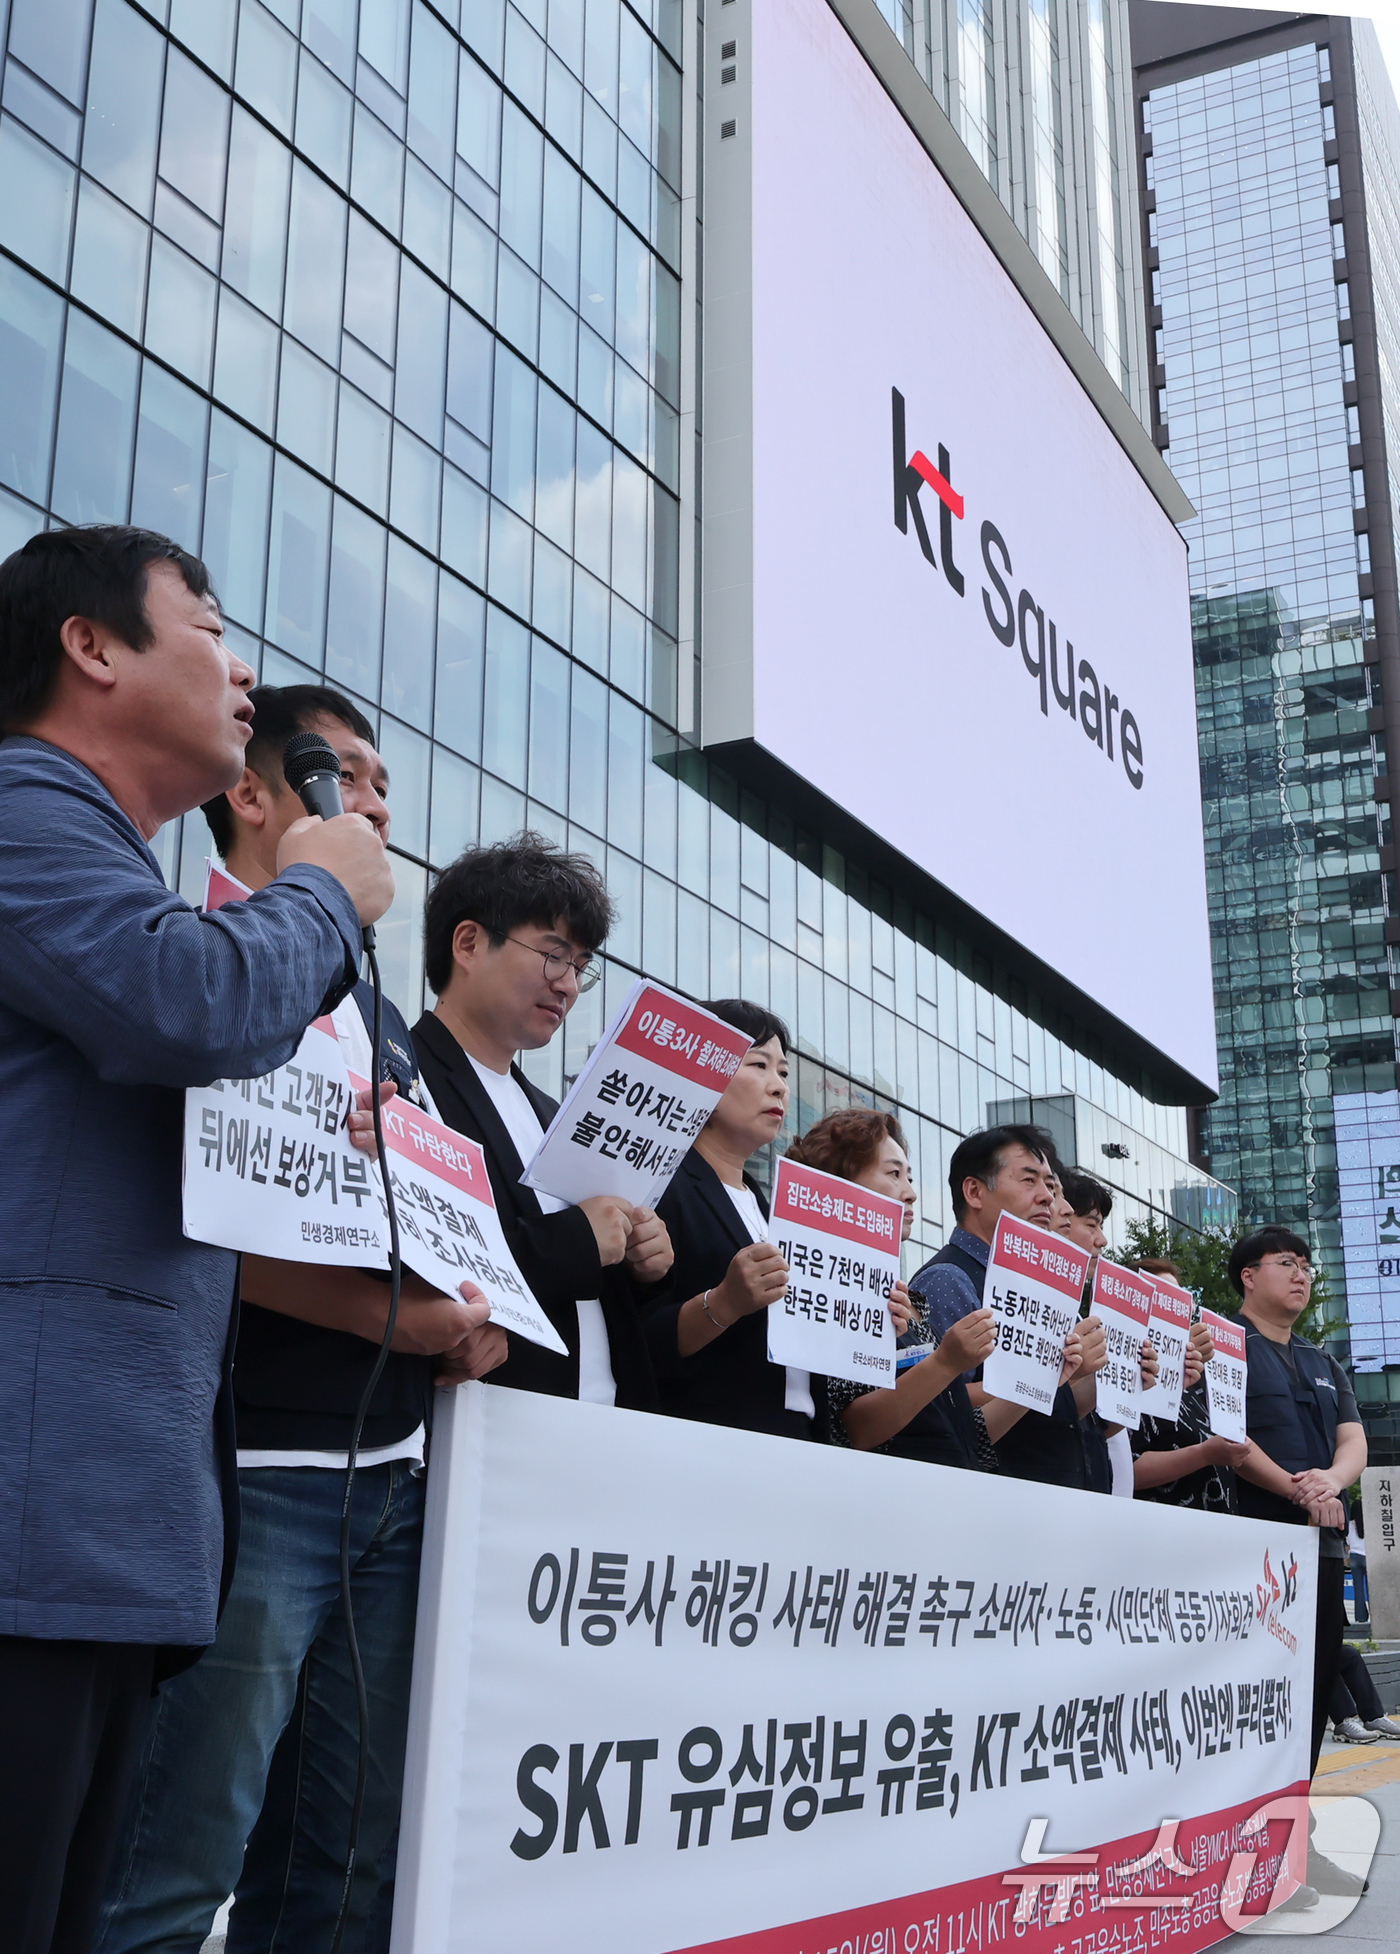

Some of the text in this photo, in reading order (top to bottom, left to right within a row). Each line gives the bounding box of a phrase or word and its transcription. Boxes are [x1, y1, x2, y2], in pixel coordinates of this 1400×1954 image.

[891, 385, 1144, 791] kt Square
[637, 1010, 702, 1060] 이통3사
[597, 1068, 689, 1132] 쏟아지는
[199, 1106, 372, 1207] 뒤에선 보상거부
[382, 1105, 405, 1139] KT
[409, 1120, 473, 1180] 규탄한다
[570, 1111, 669, 1176] 불안해서
[301, 1221, 380, 1248] 민생경제연구소
[390, 1169, 489, 1251] 소액결제
[786, 1181, 894, 1240] 집단소송제도 도입하라
[425, 1228, 530, 1303] 조사하라
[778, 1239, 895, 1300] 미국은 7천억 배상
[1003, 1231, 1083, 1287] 반복되는 개인정보 유출
[1100, 1273, 1114, 1296] 해킹
[783, 1285, 884, 1338] 한국은 배상 0원
[990, 1285, 1073, 1338] 노동자만 죽어난다
[852, 1351, 891, 1372] 한국소비자연맹
[527, 1547, 677, 1647] 이통사
[685, 1559, 769, 1648] 해킹
[773, 1565, 850, 1648] 사태
[853, 1571, 917, 1647] 해결
[919, 1575, 975, 1647] 촉구
[1174, 1589, 1254, 1643] 공동기자회견
[1267, 1608, 1297, 1656] telecom
[509, 1738, 659, 1861] SKT
[669, 1715, 867, 1850] 유심정보
[876, 1708, 960, 1819] 유출,
[970, 1712, 1021, 1792] KT
[1020, 1693, 1128, 1784] 소액결제
[1129, 1688, 1182, 1775] 사태,
[1180, 1682, 1233, 1760] 이번엔
[946, 1901, 983, 1954] 11시
[988, 1899, 1010, 1943] KT
